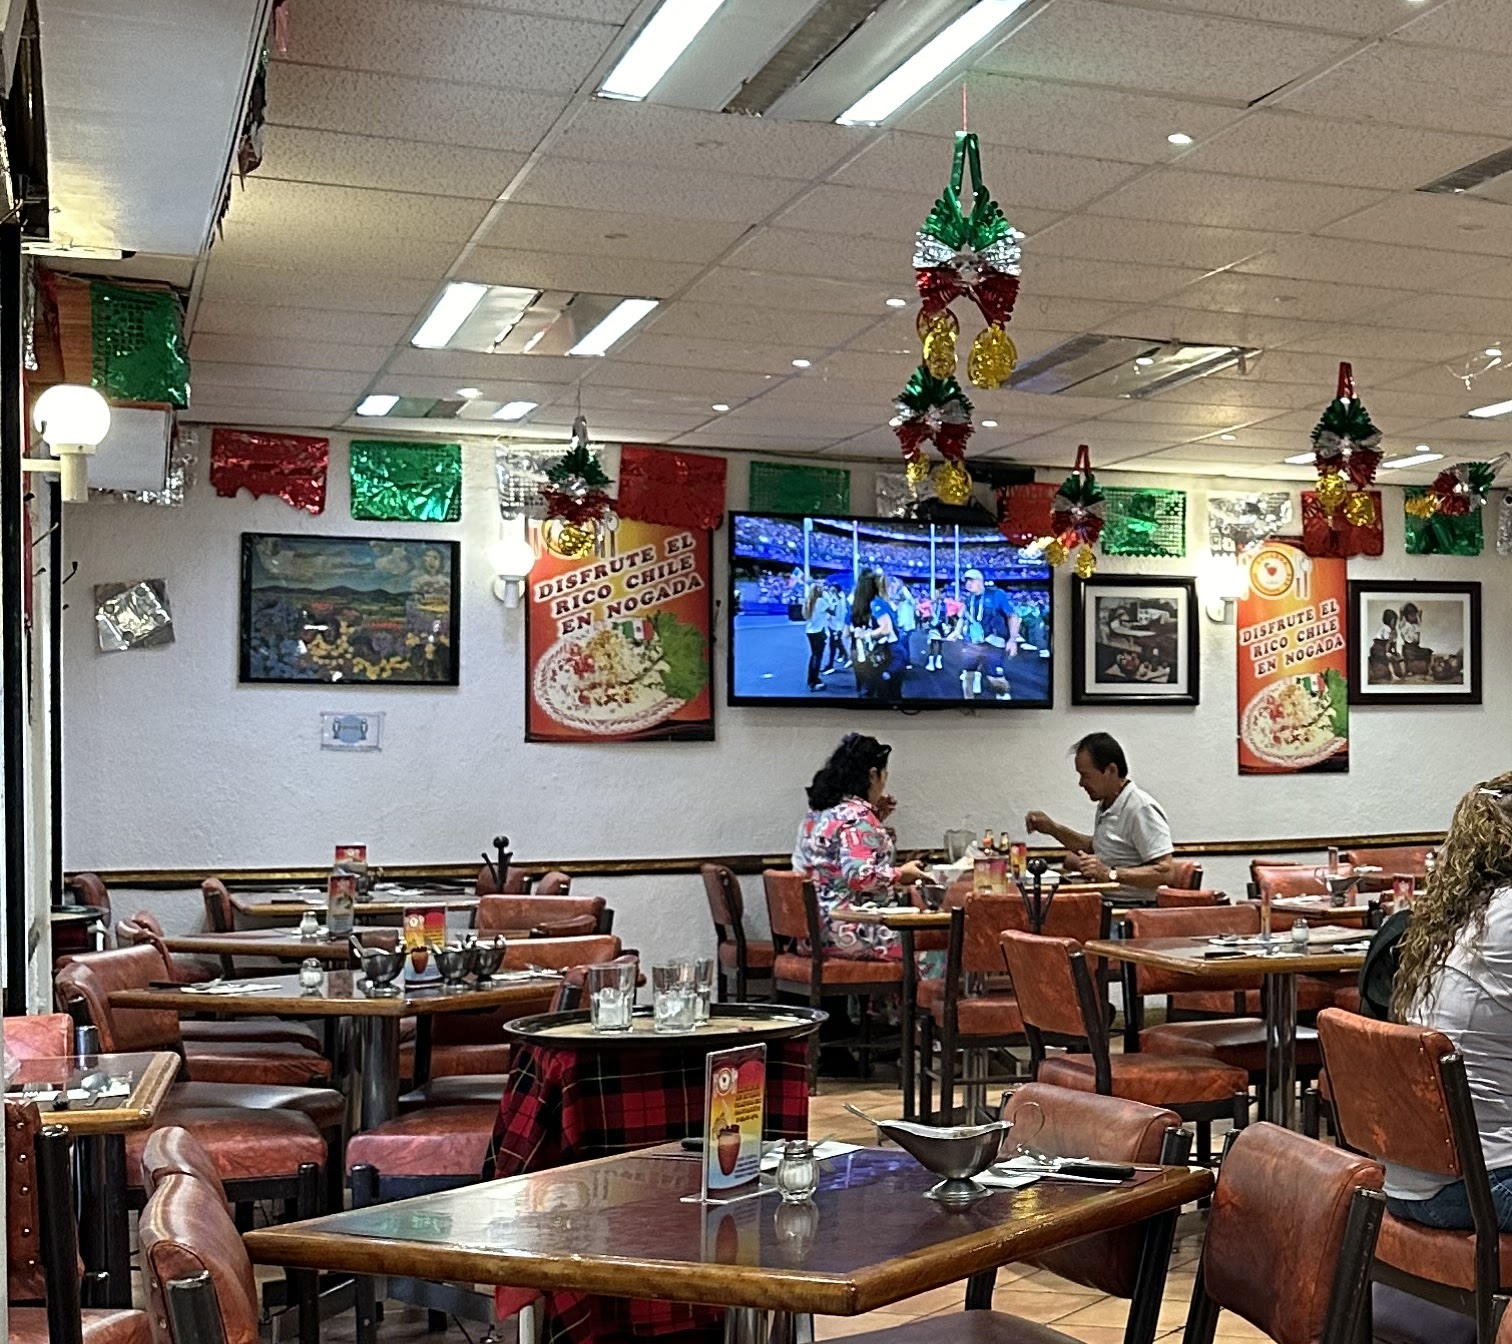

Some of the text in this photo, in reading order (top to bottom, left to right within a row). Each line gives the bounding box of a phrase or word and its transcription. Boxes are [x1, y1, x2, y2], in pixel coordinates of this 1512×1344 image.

[538, 534, 693, 599] DISFRUTE EL
[555, 555, 693, 615] RICO CHILE
[562, 575, 702, 635] EN NOGADA
[1242, 601, 1338, 643] DISFRUTE EL
[1253, 619, 1337, 658] RICO CHILE
[1257, 636, 1343, 675] EN NOGADA
